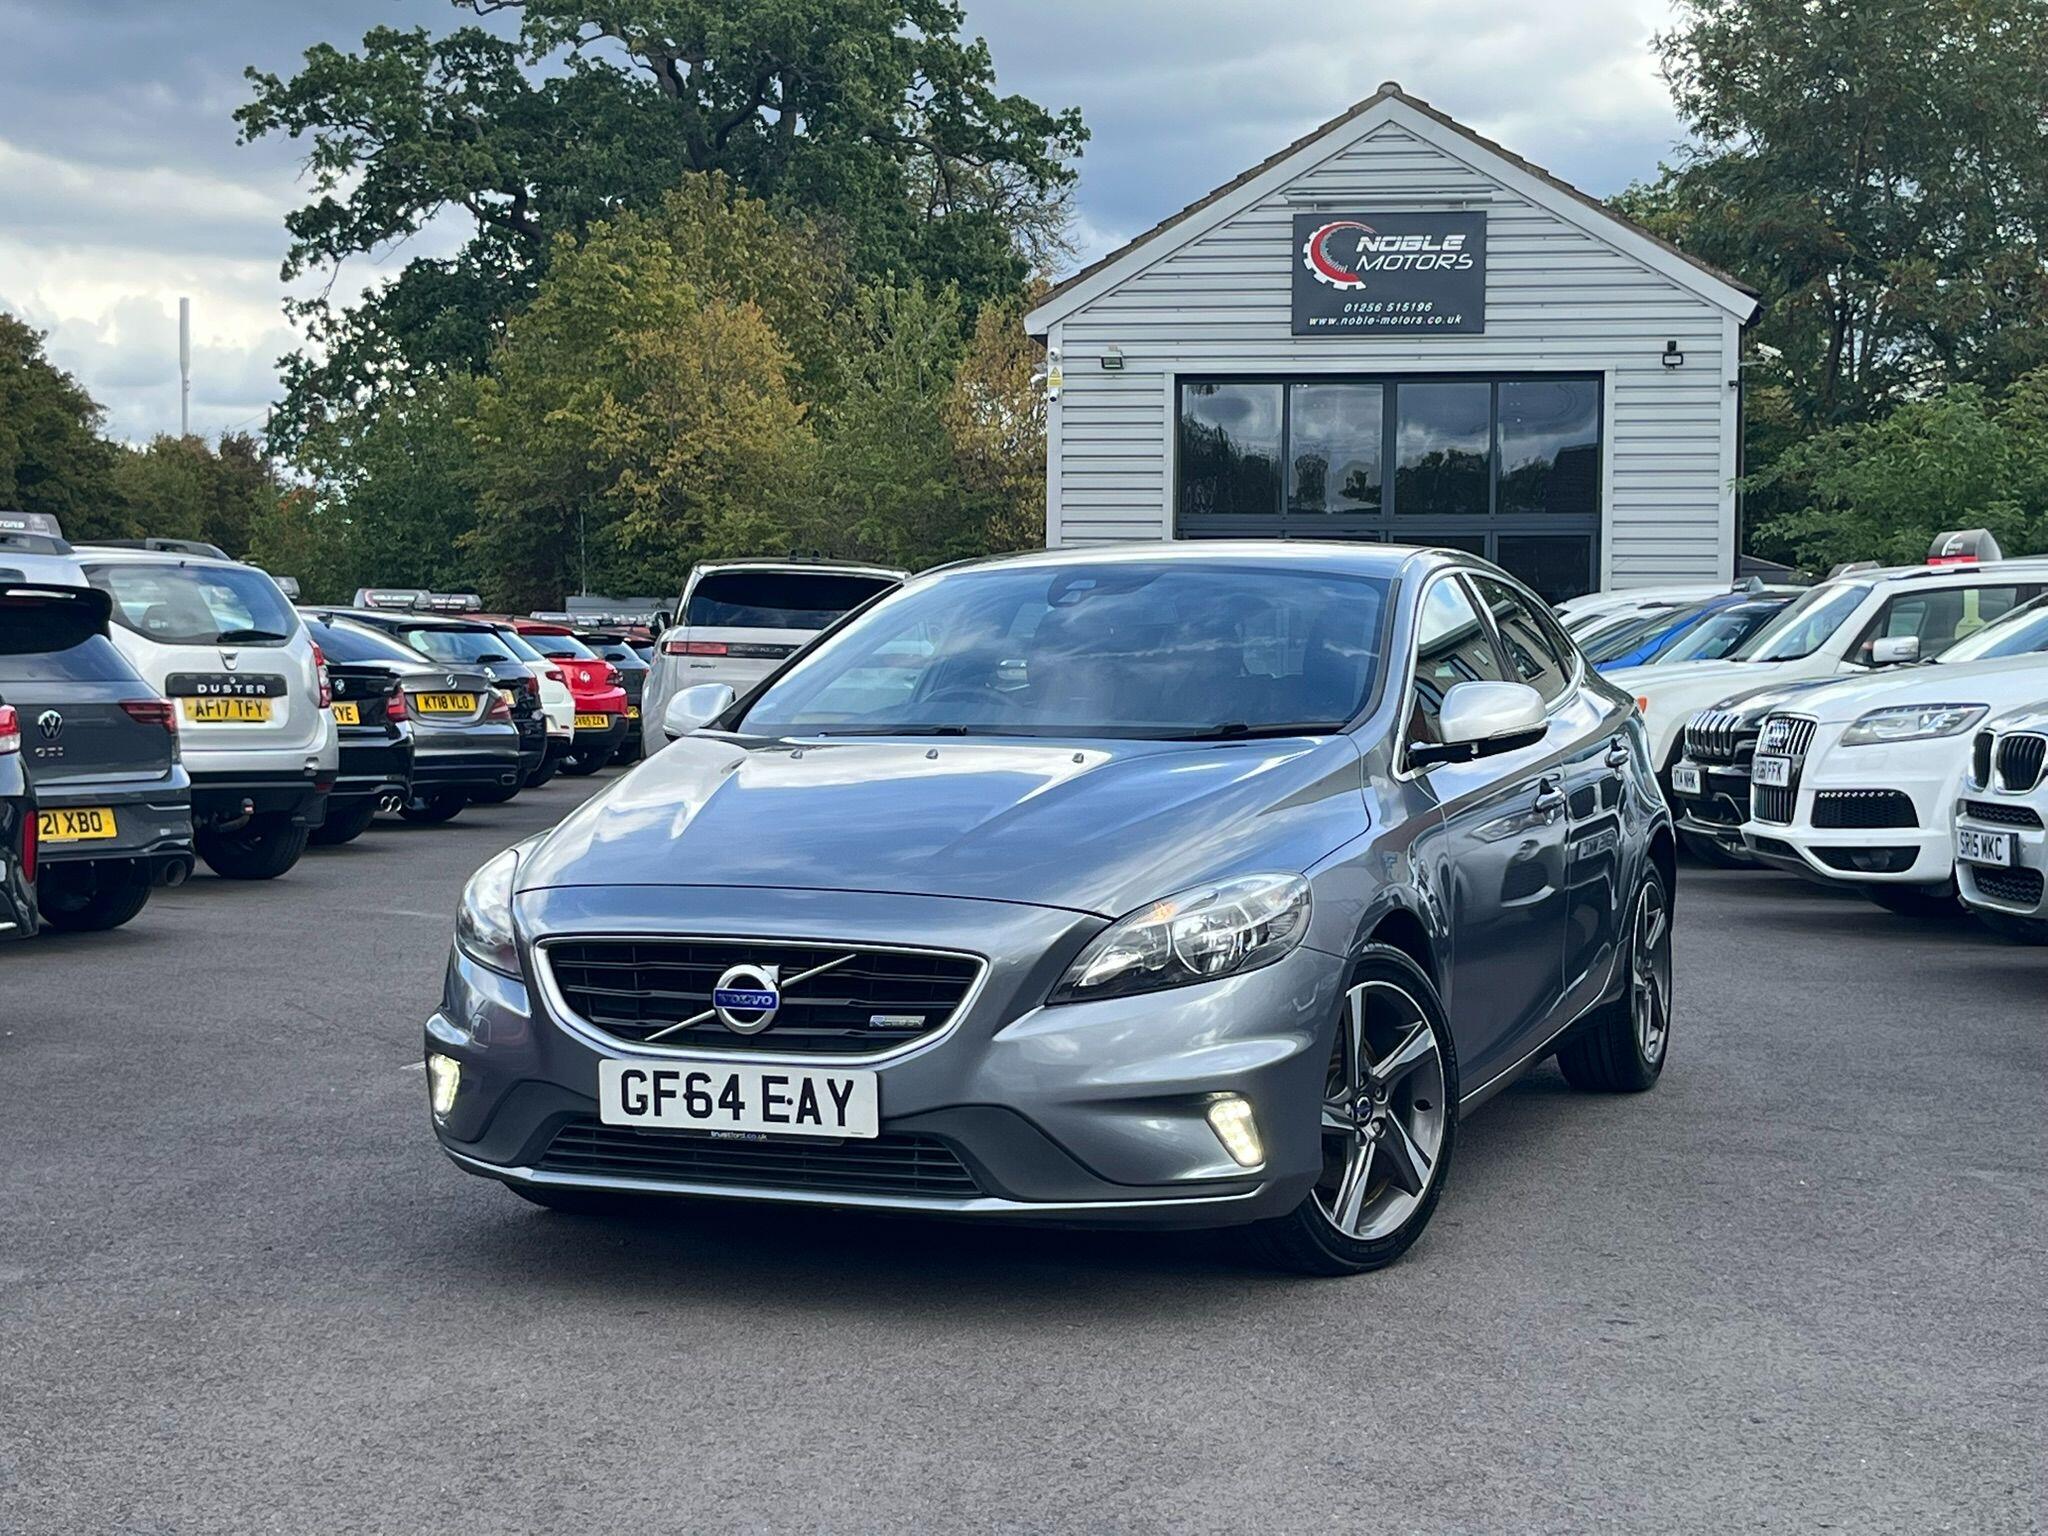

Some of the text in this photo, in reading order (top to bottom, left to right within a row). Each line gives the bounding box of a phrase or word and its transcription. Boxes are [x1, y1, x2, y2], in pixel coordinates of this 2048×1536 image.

[1355, 234, 1466, 252] NOBLE
[1355, 253, 1474, 271] MOTORS
[1344, 302, 1433, 313] 01256 515196
[1309, 314, 1462, 326] www.noble-motors.co.uk
[197, 683, 266, 694] DUSTER
[196, 700, 263, 717] AF17 TFY
[423, 693, 448, 708] KT18
[63, 811, 103, 834] XBO
[717, 993, 773, 1006] VOLVO
[620, 1069, 855, 1127] GF64 EAY
